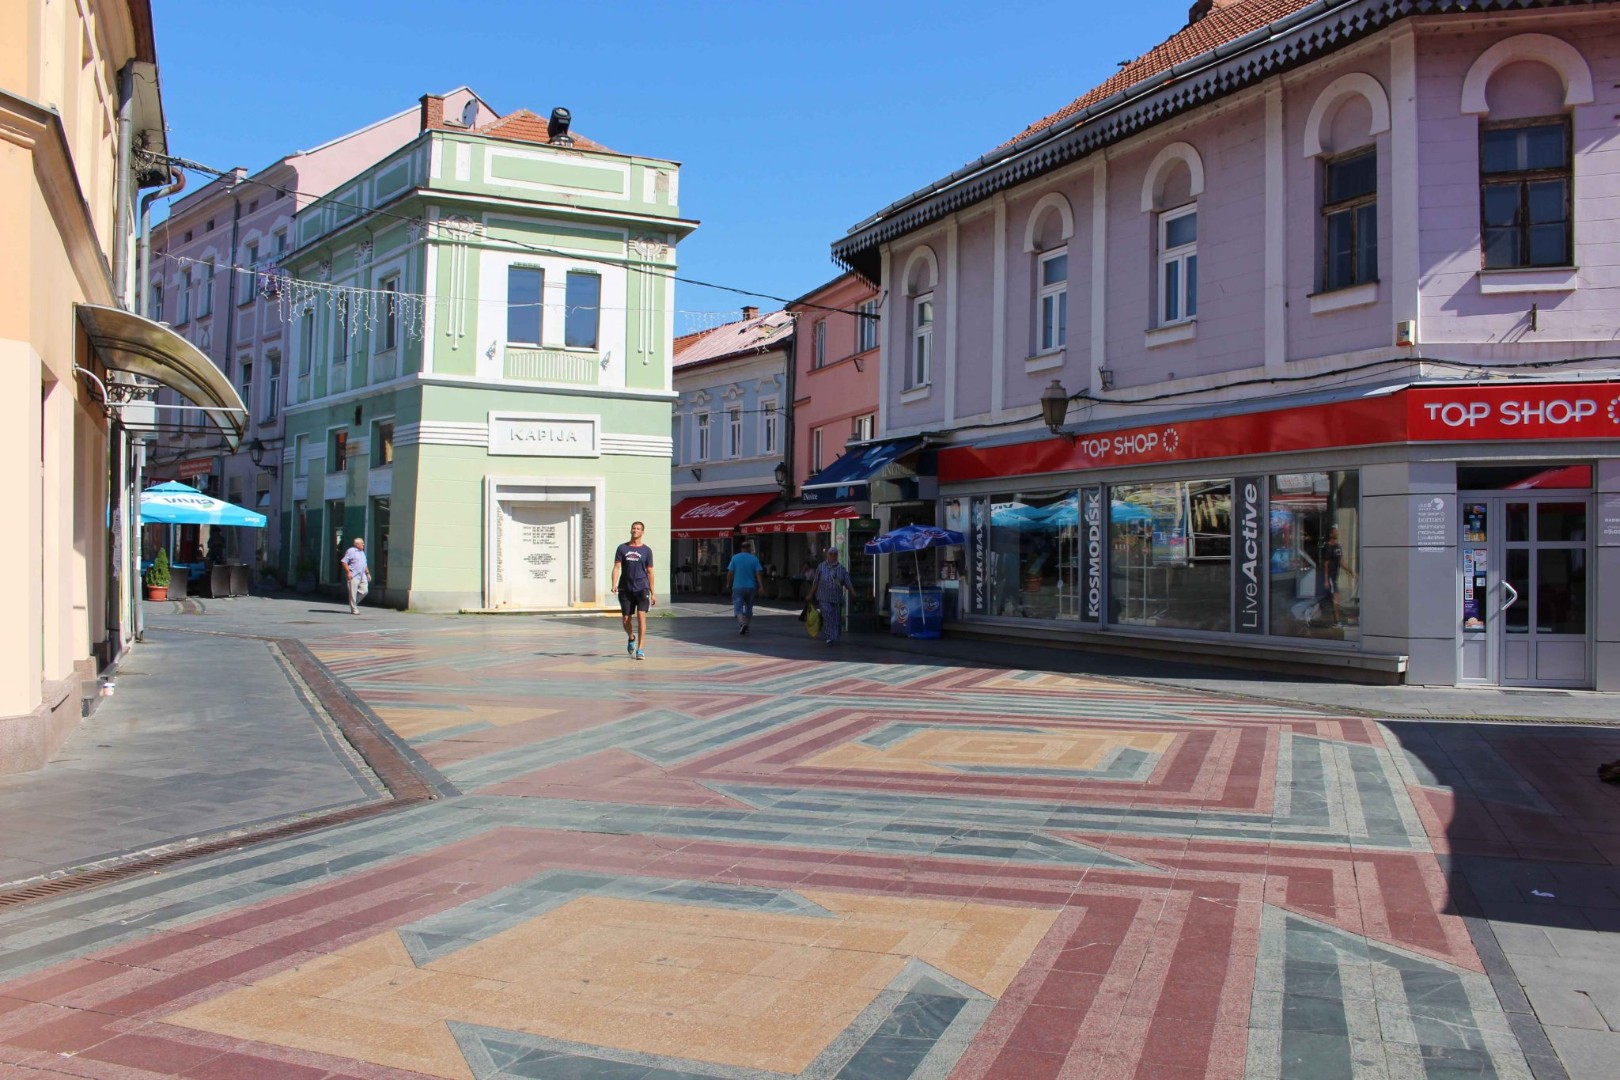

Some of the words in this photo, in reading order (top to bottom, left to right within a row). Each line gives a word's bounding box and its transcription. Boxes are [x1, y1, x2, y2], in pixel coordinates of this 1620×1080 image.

[1424, 401, 1491, 427] TOP
[1500, 399, 1598, 426] SHOP
[510, 427, 577, 442] KAPIJA
[1081, 438, 1111, 458] TOP
[1114, 432, 1159, 456] SHOP
[1242, 483, 1258, 628] LiveActive
